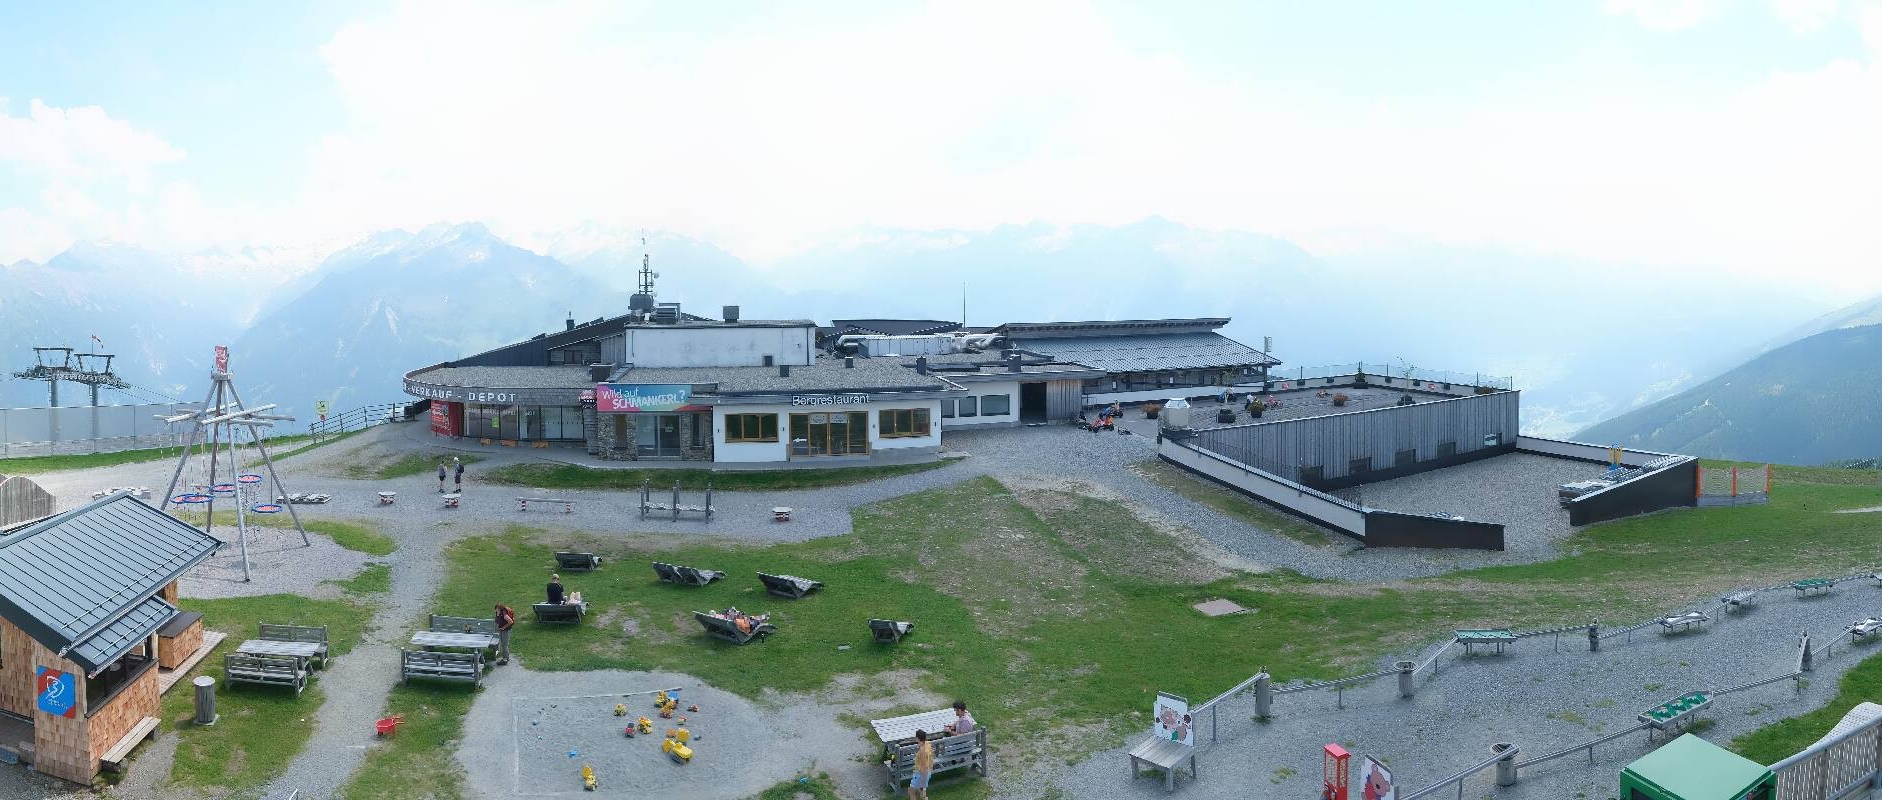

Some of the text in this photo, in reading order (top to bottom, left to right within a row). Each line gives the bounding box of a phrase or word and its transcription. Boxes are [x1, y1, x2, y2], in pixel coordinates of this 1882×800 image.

[411, 385, 452, 399] VERKAUF
[468, 392, 516, 402] DEPOT
[602, 389, 622, 400] Wild
[624, 387, 639, 397] auf
[613, 390, 686, 409] SCHMANKERL?
[792, 394, 870, 406] Bergrestaurant
